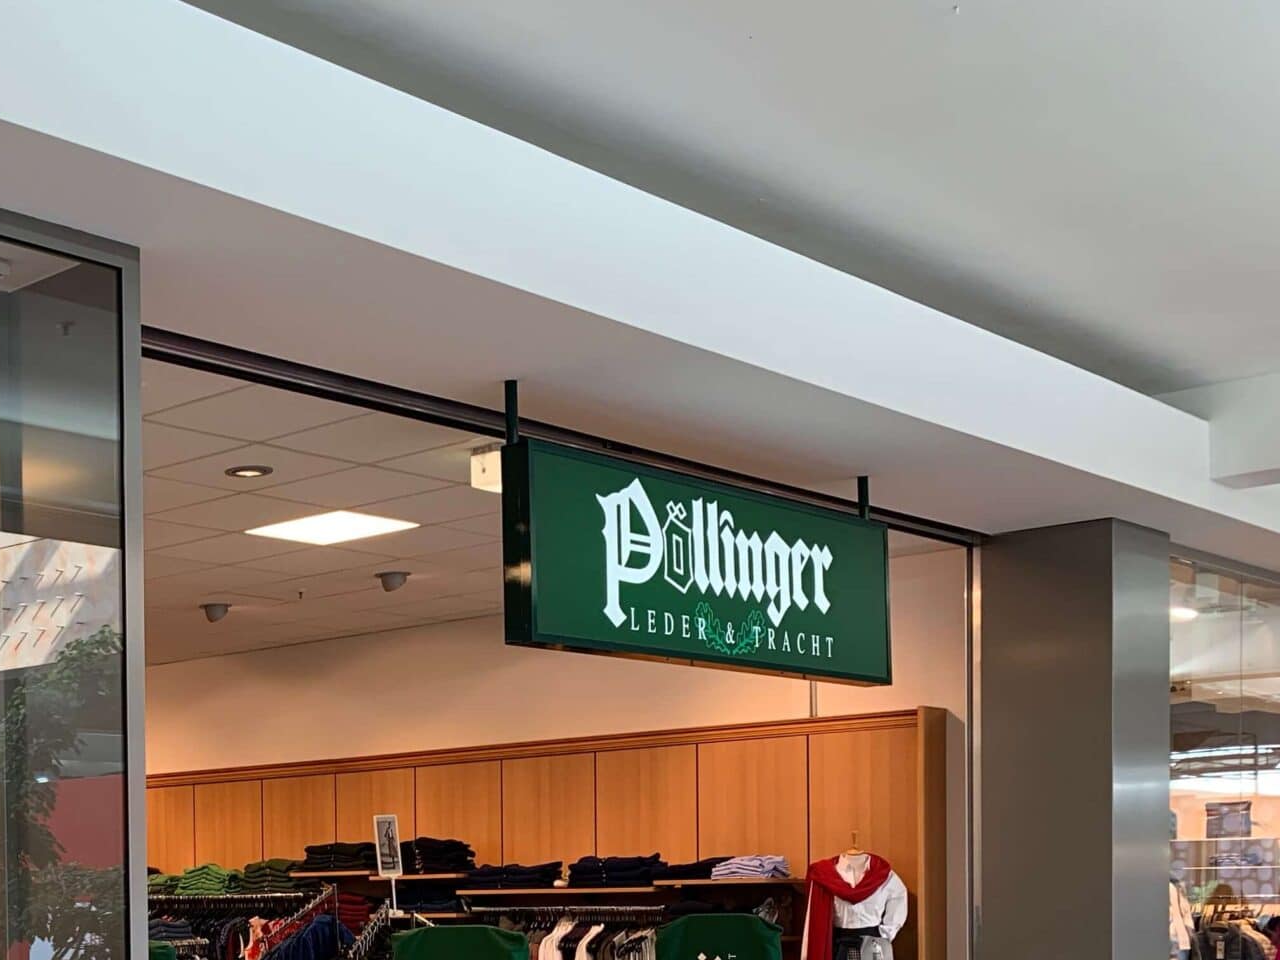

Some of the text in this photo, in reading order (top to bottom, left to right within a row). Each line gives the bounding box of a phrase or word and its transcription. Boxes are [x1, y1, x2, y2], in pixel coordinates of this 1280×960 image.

[595, 477, 833, 628] Pöllinger
[630, 606, 834, 658] LEDER & TRACHT
